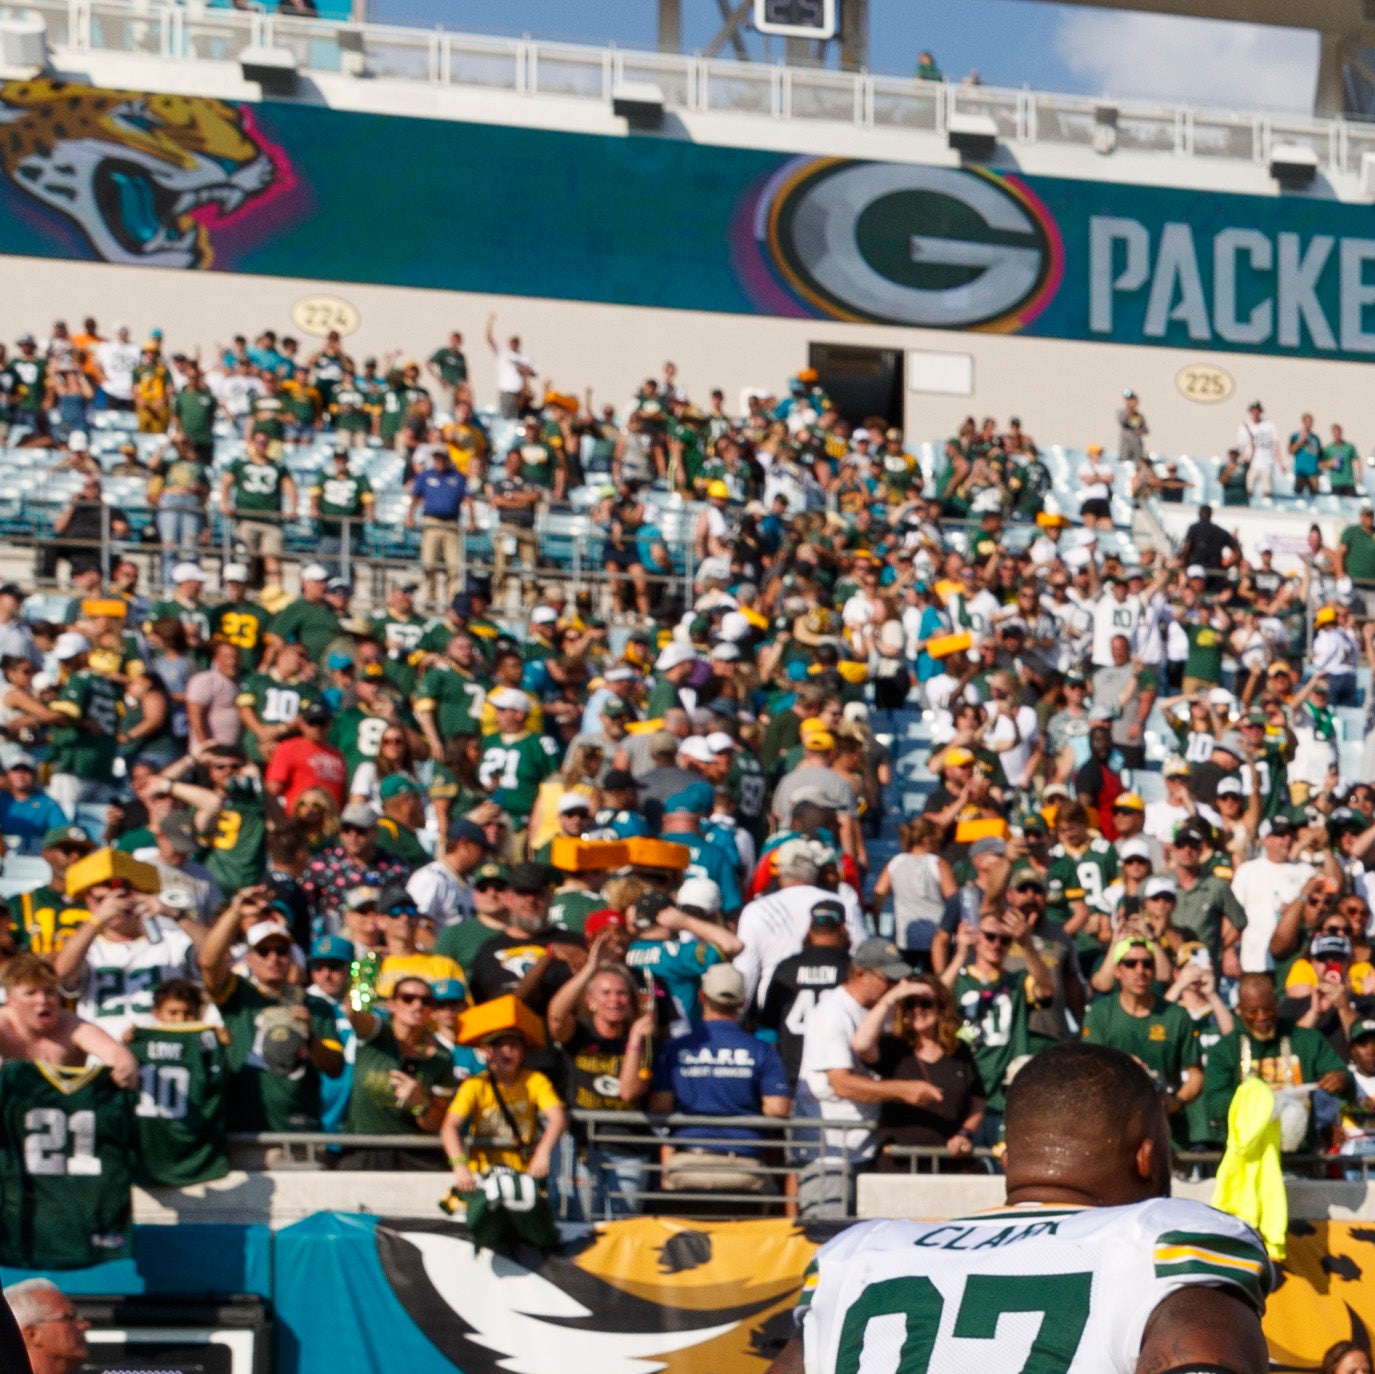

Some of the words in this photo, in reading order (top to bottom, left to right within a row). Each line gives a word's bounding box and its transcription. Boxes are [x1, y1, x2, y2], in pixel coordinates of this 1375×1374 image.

[305, 304, 348, 326] 224
[1185, 372, 1226, 395] 225
[262, 687, 301, 724] 10
[478, 747, 522, 791] 21
[134, 1063, 191, 1120] 10
[23, 1106, 103, 1176] 21
